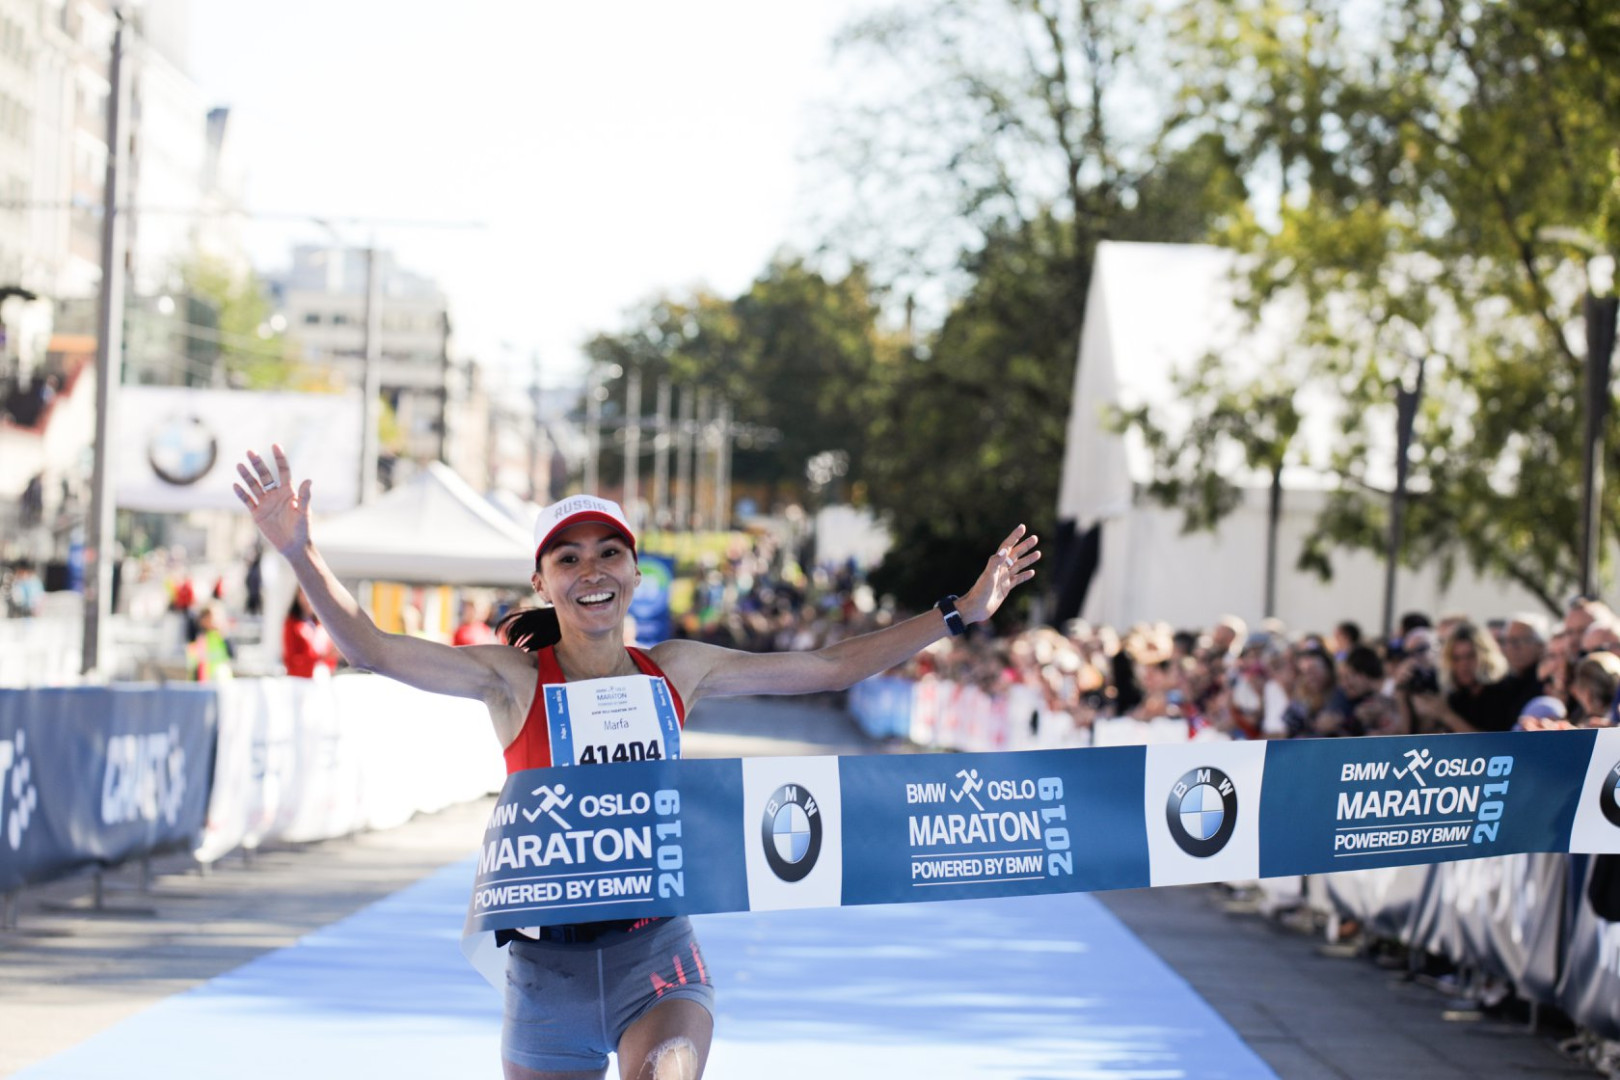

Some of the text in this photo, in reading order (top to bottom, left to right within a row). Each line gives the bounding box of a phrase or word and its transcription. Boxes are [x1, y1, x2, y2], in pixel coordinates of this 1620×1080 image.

[604, 717, 630, 731] Marfa
[580, 740, 662, 765] 41404
[1172, 769, 1234, 799] BMW
[1340, 758, 1486, 782] BMW OSLO
[766, 786, 818, 818] BMW
[906, 779, 1036, 804] BMW OSLO
[1336, 785, 1480, 820] MARATON
[1472, 755, 1514, 844] 2019
[488, 792, 651, 829] MW OSLO
[1037, 777, 1073, 877] 2019
[654, 789, 685, 899] 2019
[908, 811, 1042, 846] MARATON
[1334, 826, 1471, 851] POWERED BY BMW
[477, 826, 653, 876] MARATON
[911, 855, 1043, 879] POWERED BY BMW
[474, 875, 652, 910] POWERED BY BMW
